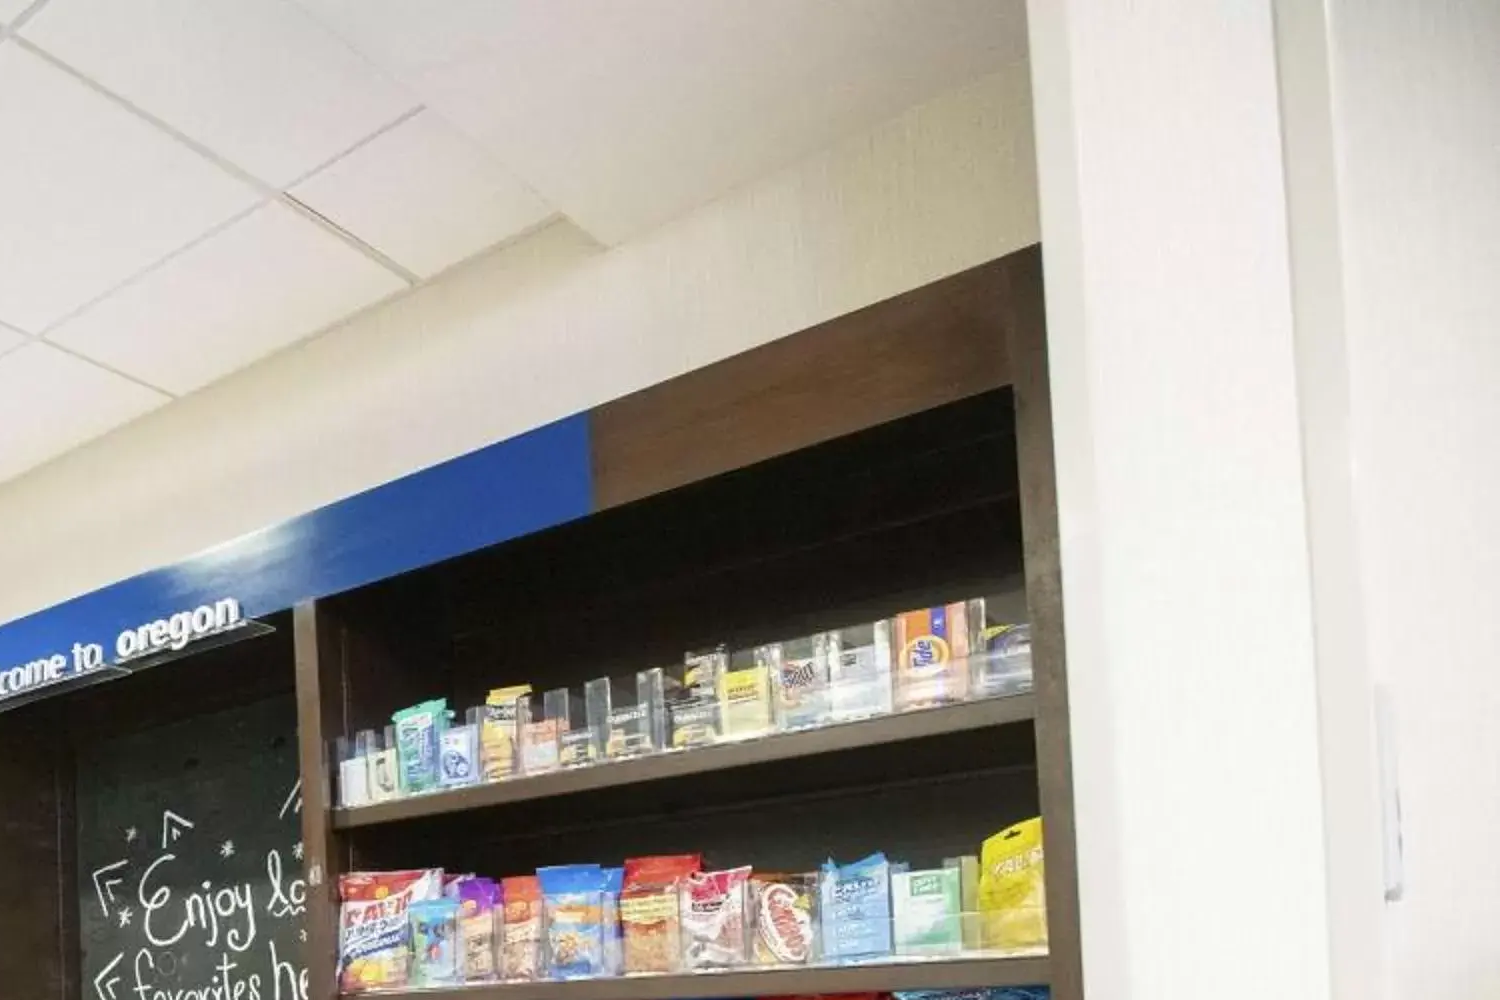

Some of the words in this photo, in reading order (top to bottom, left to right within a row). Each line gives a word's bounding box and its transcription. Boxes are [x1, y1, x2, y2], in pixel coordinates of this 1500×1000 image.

[71, 642, 104, 675] to
[116, 597, 240, 651] oregon
[139, 853, 257, 951] Enjoy
